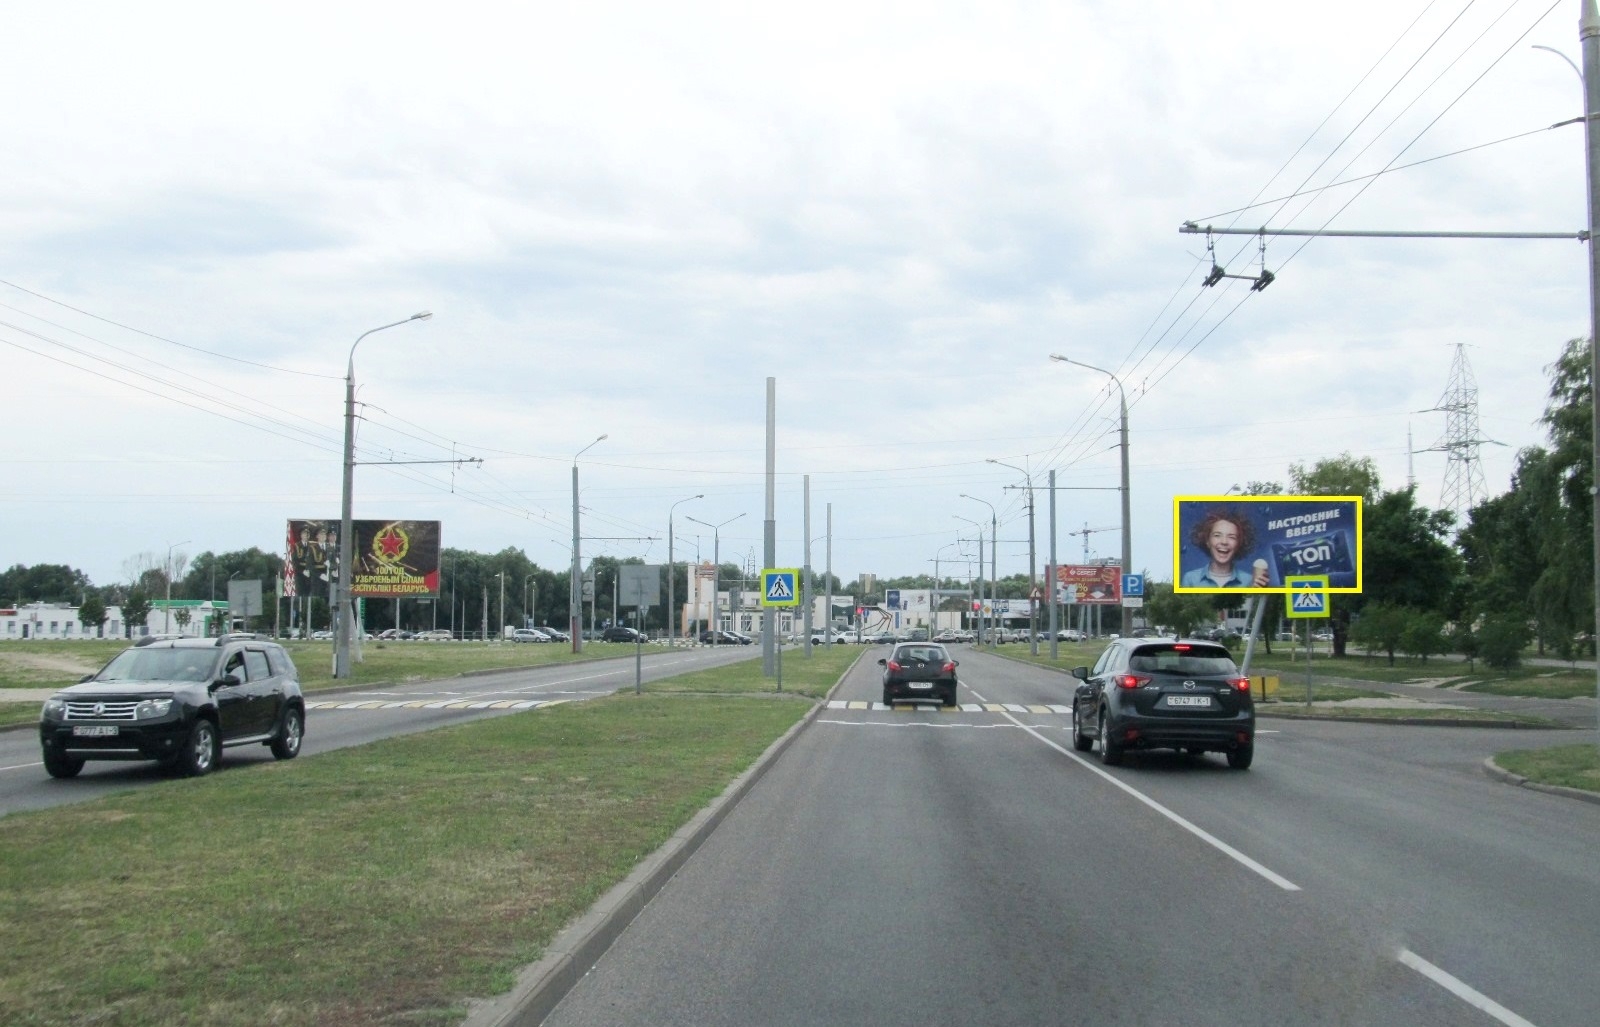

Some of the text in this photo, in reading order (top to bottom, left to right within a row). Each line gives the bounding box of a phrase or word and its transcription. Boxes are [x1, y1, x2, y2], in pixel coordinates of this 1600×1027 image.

[1268, 509, 1340, 530] НАСТРОЕНИЕ
[1286, 523, 1327, 538] ВВЕРХ!
[1291, 546, 1331, 565] ТОП
[392, 585, 430, 593] БЕЛАРУСЬ
[1174, 697, 1191, 705] 6747
